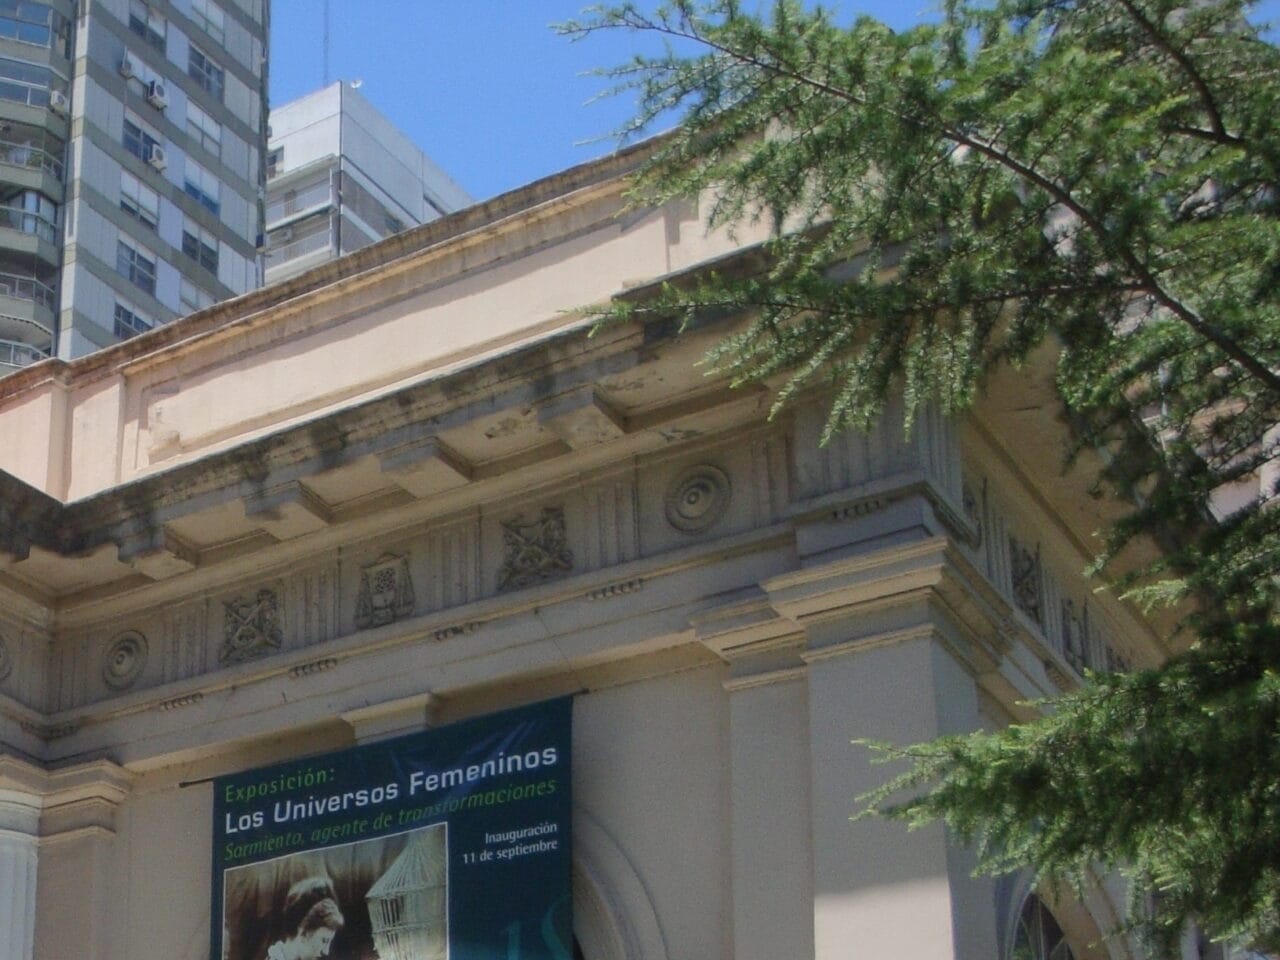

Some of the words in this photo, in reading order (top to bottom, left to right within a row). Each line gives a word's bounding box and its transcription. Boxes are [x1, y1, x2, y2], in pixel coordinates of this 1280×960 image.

[225, 767, 337, 804] Exposición:
[225, 810, 265, 835] Los
[273, 781, 399, 824] Universos
[410, 747, 558, 796] Femeninos
[223, 830, 306, 862] Sarmiento,
[311, 815, 369, 847] agente
[373, 811, 393, 832] de
[398, 777, 557, 826] transformaciones
[485, 821, 558, 845] Inauguración
[463, 852, 476, 864] 11
[479, 847, 493, 862] de
[496, 838, 559, 861] septiembre
